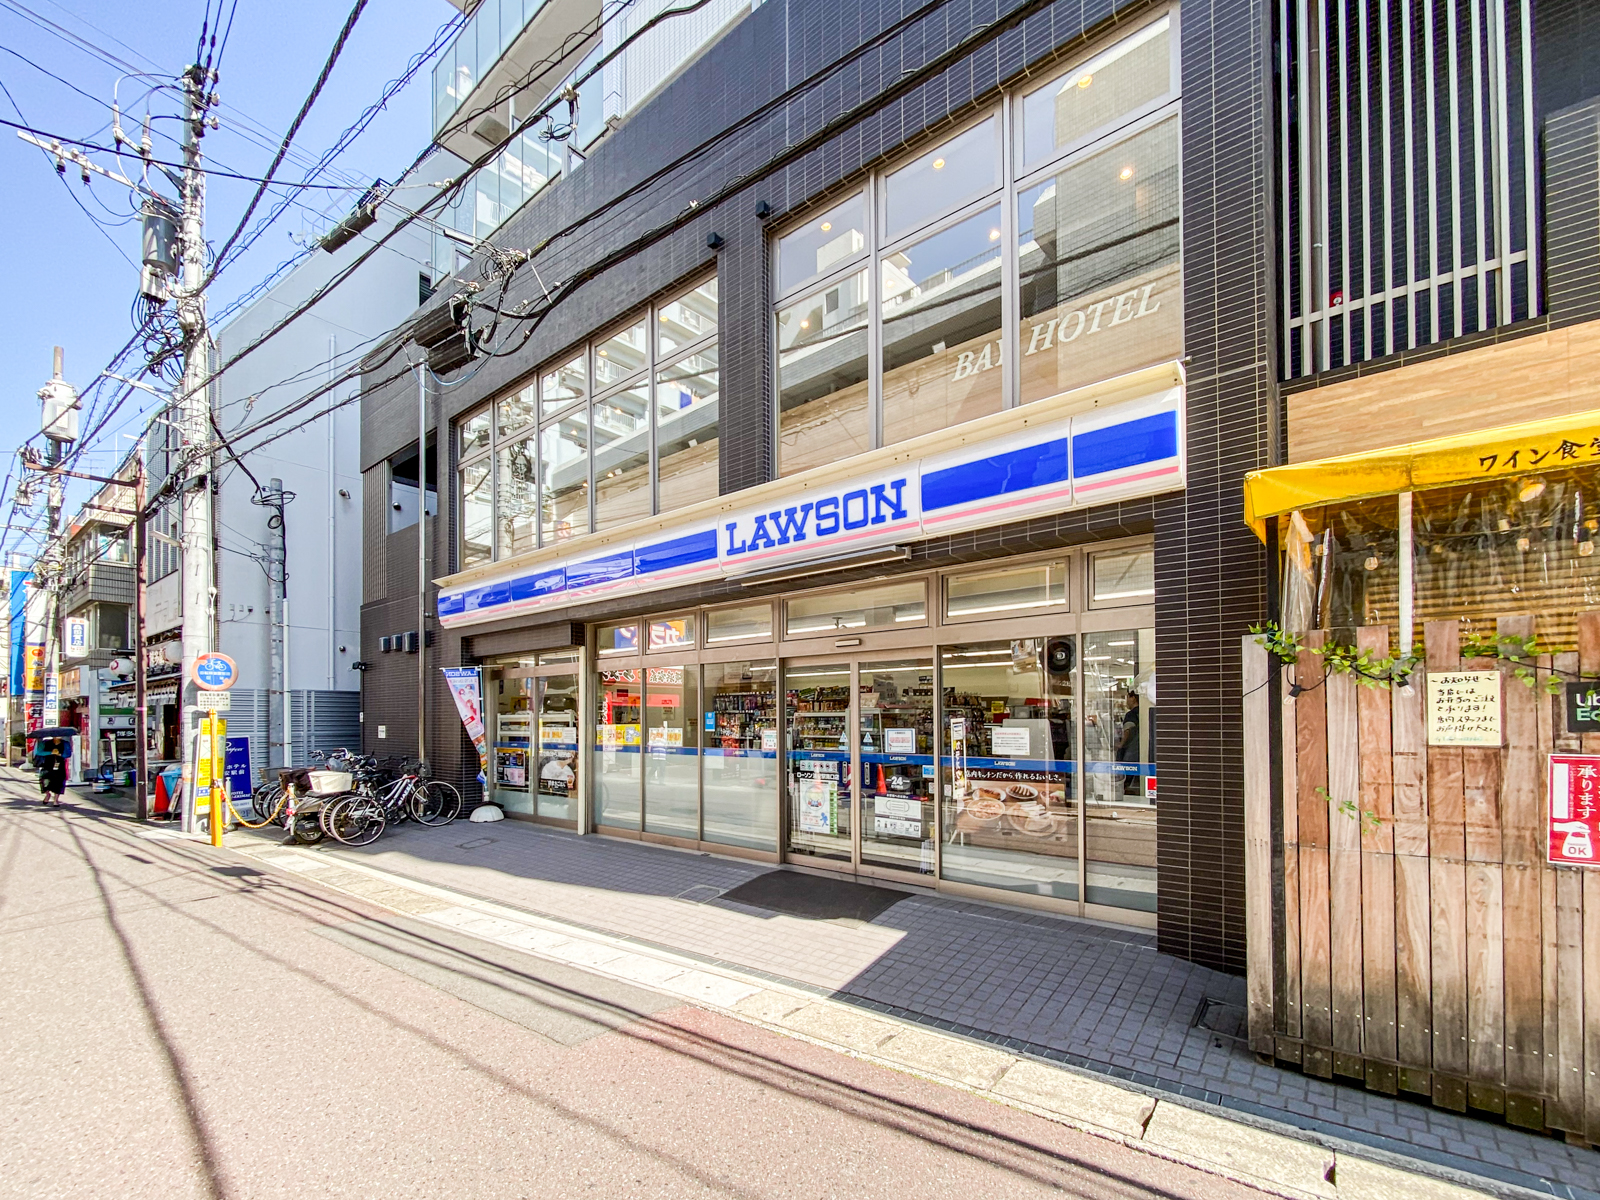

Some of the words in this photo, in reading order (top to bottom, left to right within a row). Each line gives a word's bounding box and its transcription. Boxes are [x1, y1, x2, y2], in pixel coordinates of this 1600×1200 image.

[1024, 282, 1161, 357] HOTEL
[725, 477, 908, 556] LAWSON
[891, 776, 904, 786] 24
[1577, 764, 1597, 820] 承ります
[1568, 846, 1588, 856] OK
